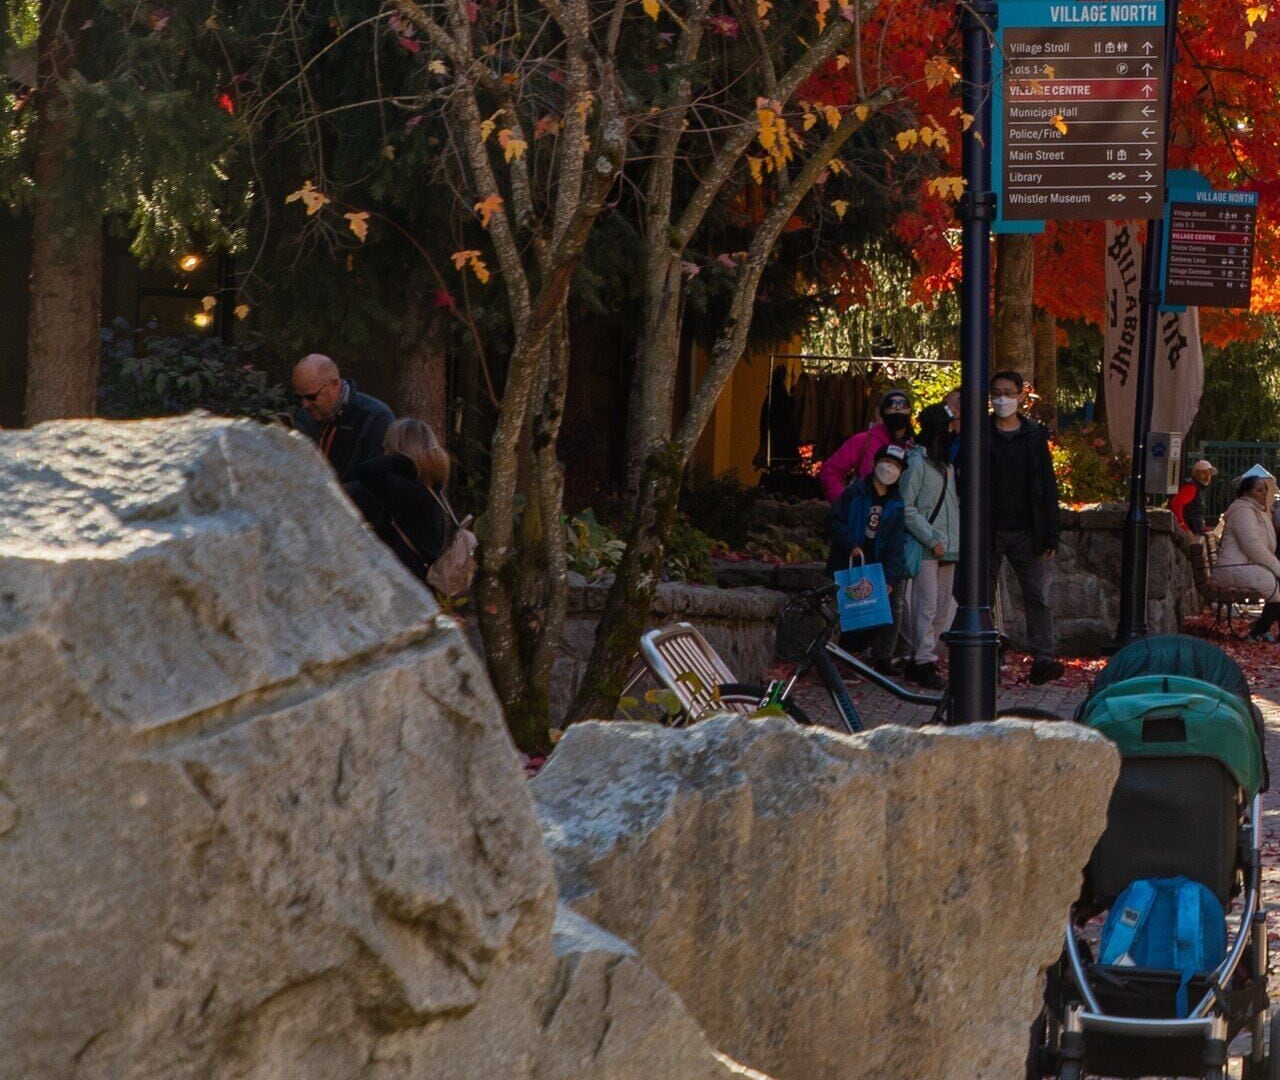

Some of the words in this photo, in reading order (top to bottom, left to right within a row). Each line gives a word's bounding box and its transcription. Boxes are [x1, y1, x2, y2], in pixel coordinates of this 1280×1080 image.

[1050, 5, 1107, 22] VILLAGE
[1111, 5, 1157, 22] NORTH
[1010, 43, 1042, 55] Village
[1044, 42, 1070, 53] Stroll
[1010, 85, 1050, 96] VILLAE
[1051, 85, 1091, 96] CENTRE
[1009, 107, 1057, 119] Municipal
[1059, 106, 1078, 117] Hall
[1009, 128, 1062, 139] Police/Fire
[1009, 150, 1033, 161] Main
[1035, 149, 1065, 161] Street
[1009, 171, 1043, 184] Library
[1009, 192, 1048, 204] Whistler
[1050, 192, 1091, 203] Museum
[1196, 191, 1228, 202] VILLAGE
[1228, 192, 1254, 203] NORTH
[1194, 233, 1216, 241] CENTRE
[1107, 225, 1139, 388] BILLABONG
